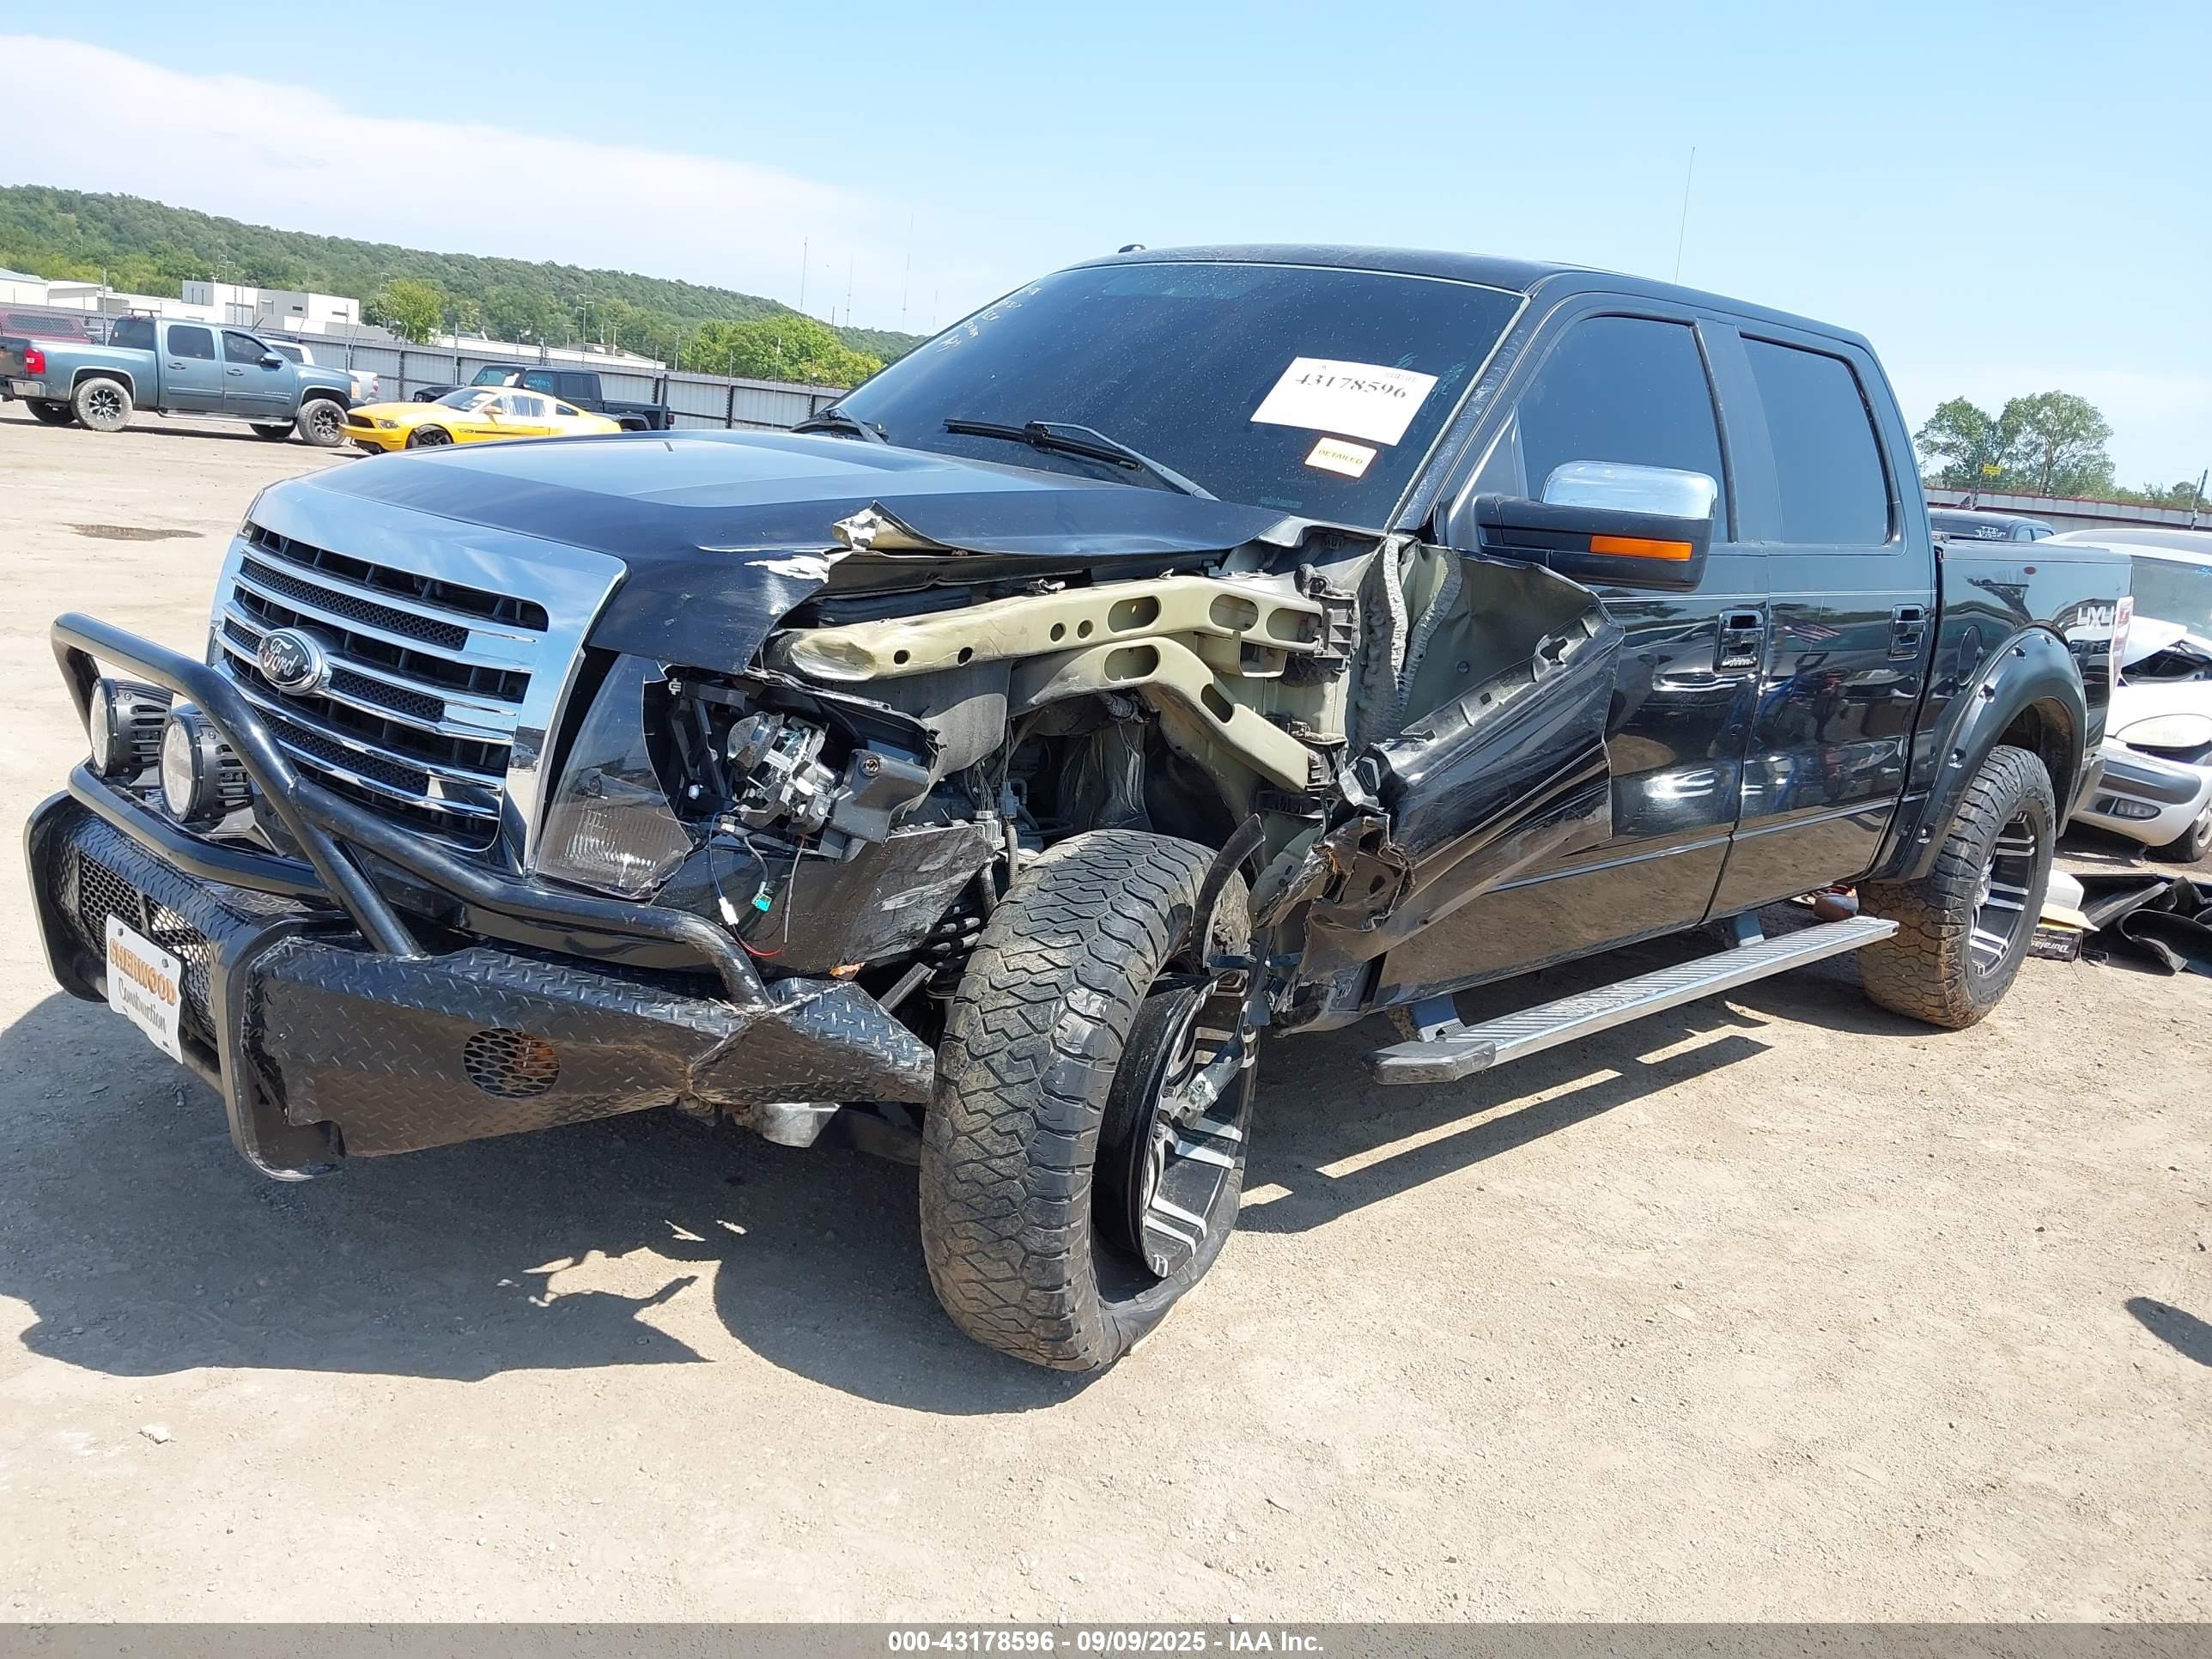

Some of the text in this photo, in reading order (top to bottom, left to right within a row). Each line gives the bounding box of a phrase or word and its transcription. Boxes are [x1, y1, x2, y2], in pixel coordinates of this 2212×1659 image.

[1295, 374, 1407, 398] 43178596
[1318, 449, 1364, 465] DETAILED
[264, 638, 298, 677] Ford
[110, 938, 176, 1006] SHERWOOD
[118, 976, 167, 1035] Construction
